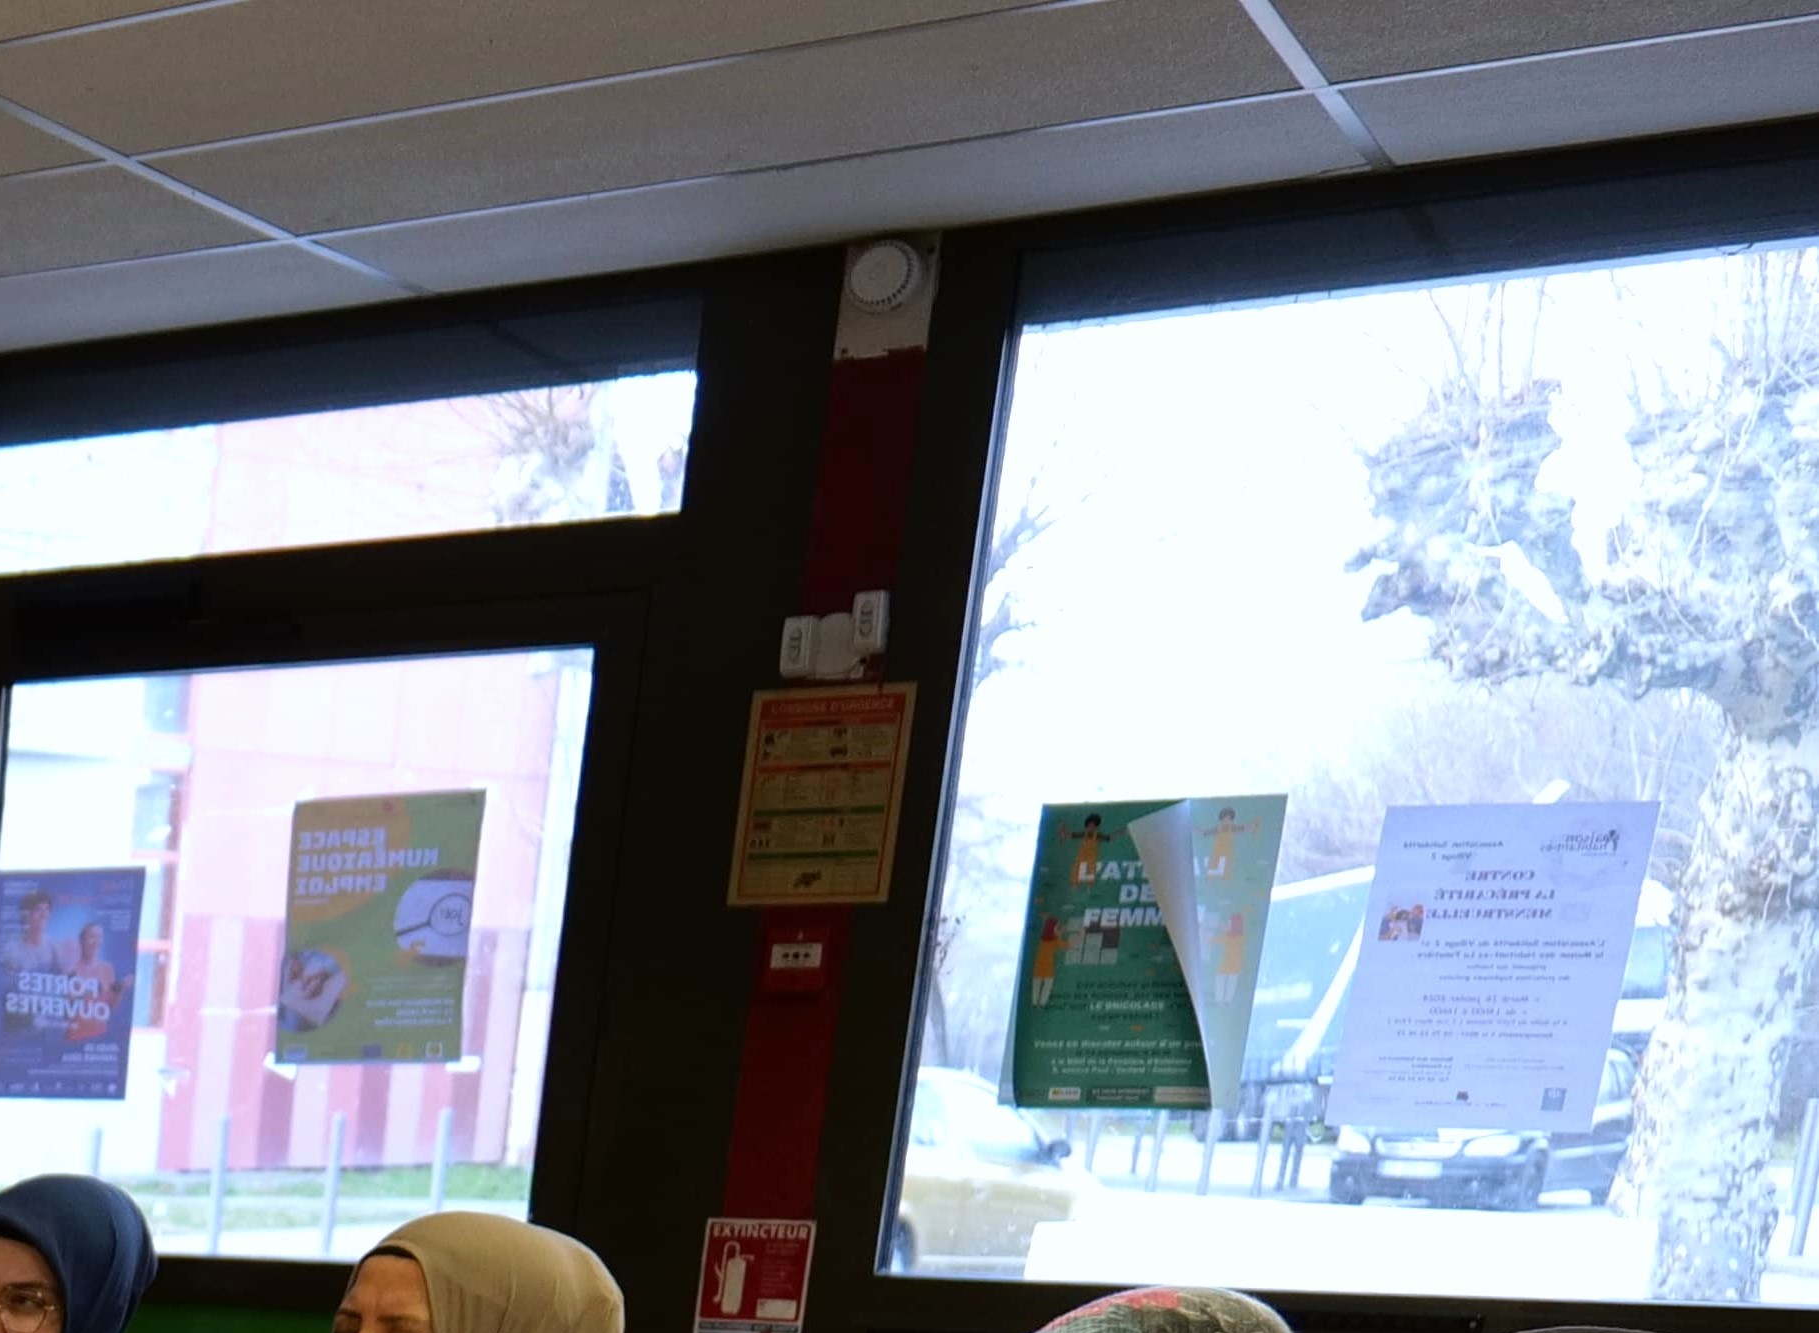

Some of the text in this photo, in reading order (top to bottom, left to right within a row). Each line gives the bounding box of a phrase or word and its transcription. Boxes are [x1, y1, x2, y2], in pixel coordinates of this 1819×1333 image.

[1118, 883, 1158, 904] DE
[1082, 907, 1166, 927] FEMM
[712, 1223, 810, 1240] EXTINCTEUR
